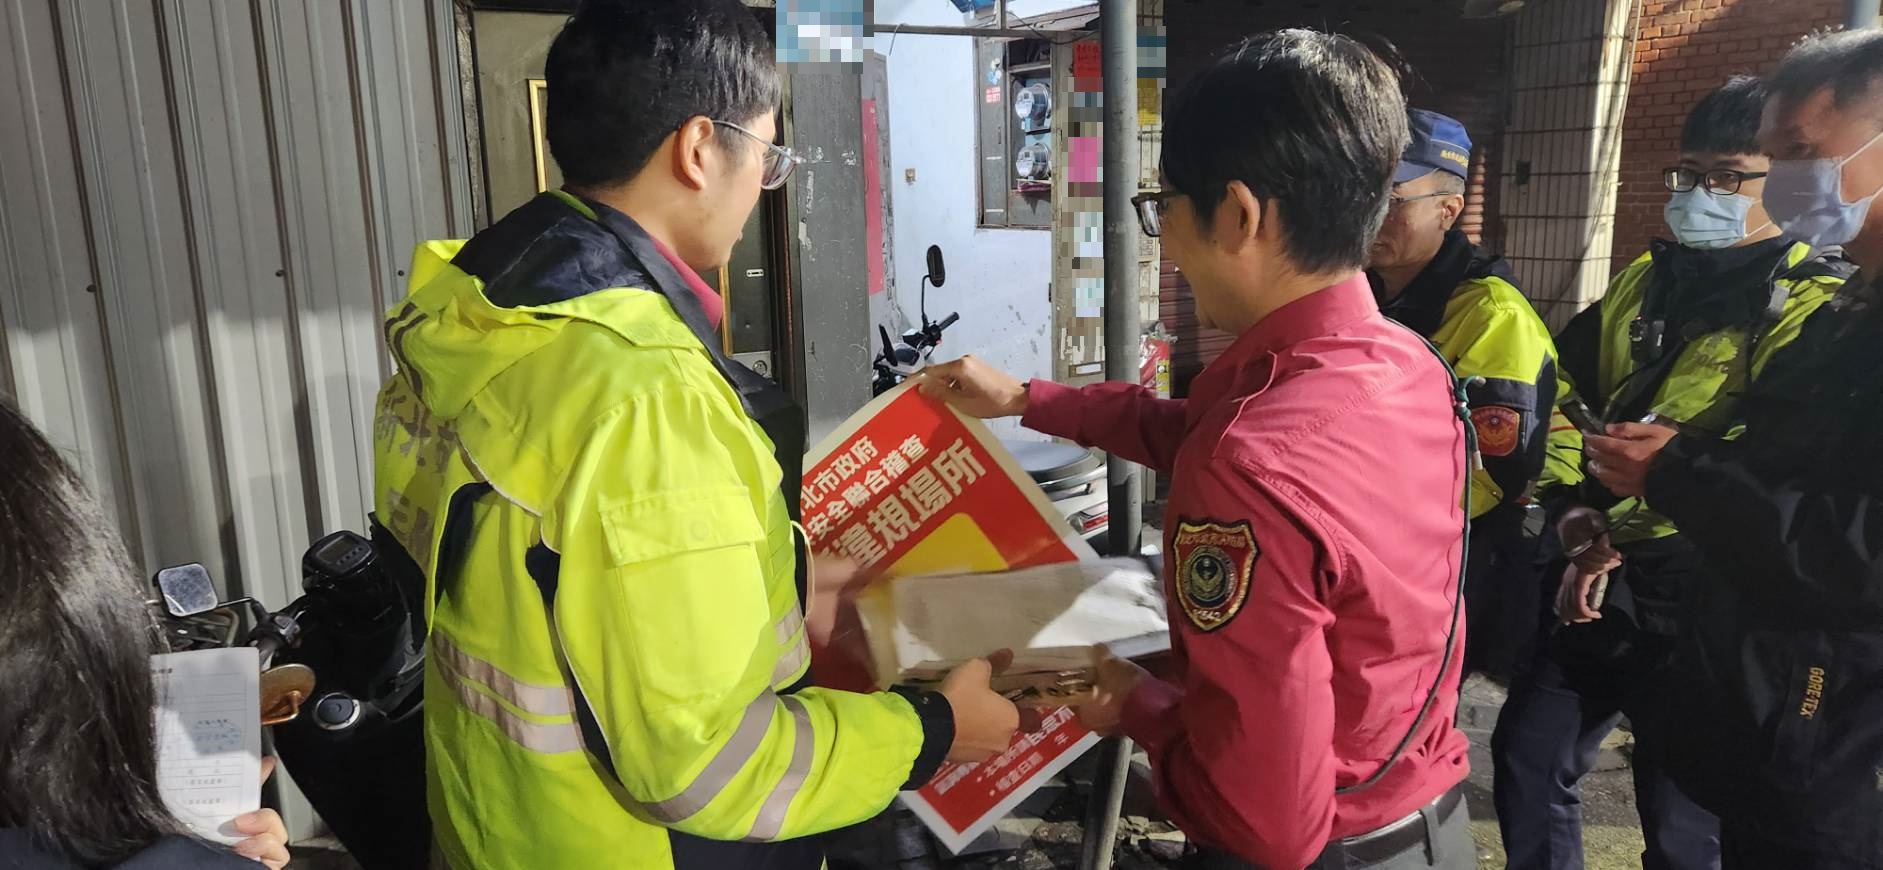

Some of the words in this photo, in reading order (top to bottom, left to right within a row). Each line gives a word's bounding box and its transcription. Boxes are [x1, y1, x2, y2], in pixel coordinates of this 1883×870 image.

[800, 435, 879, 516] 北市政府
[821, 437, 987, 569] 違規場所
